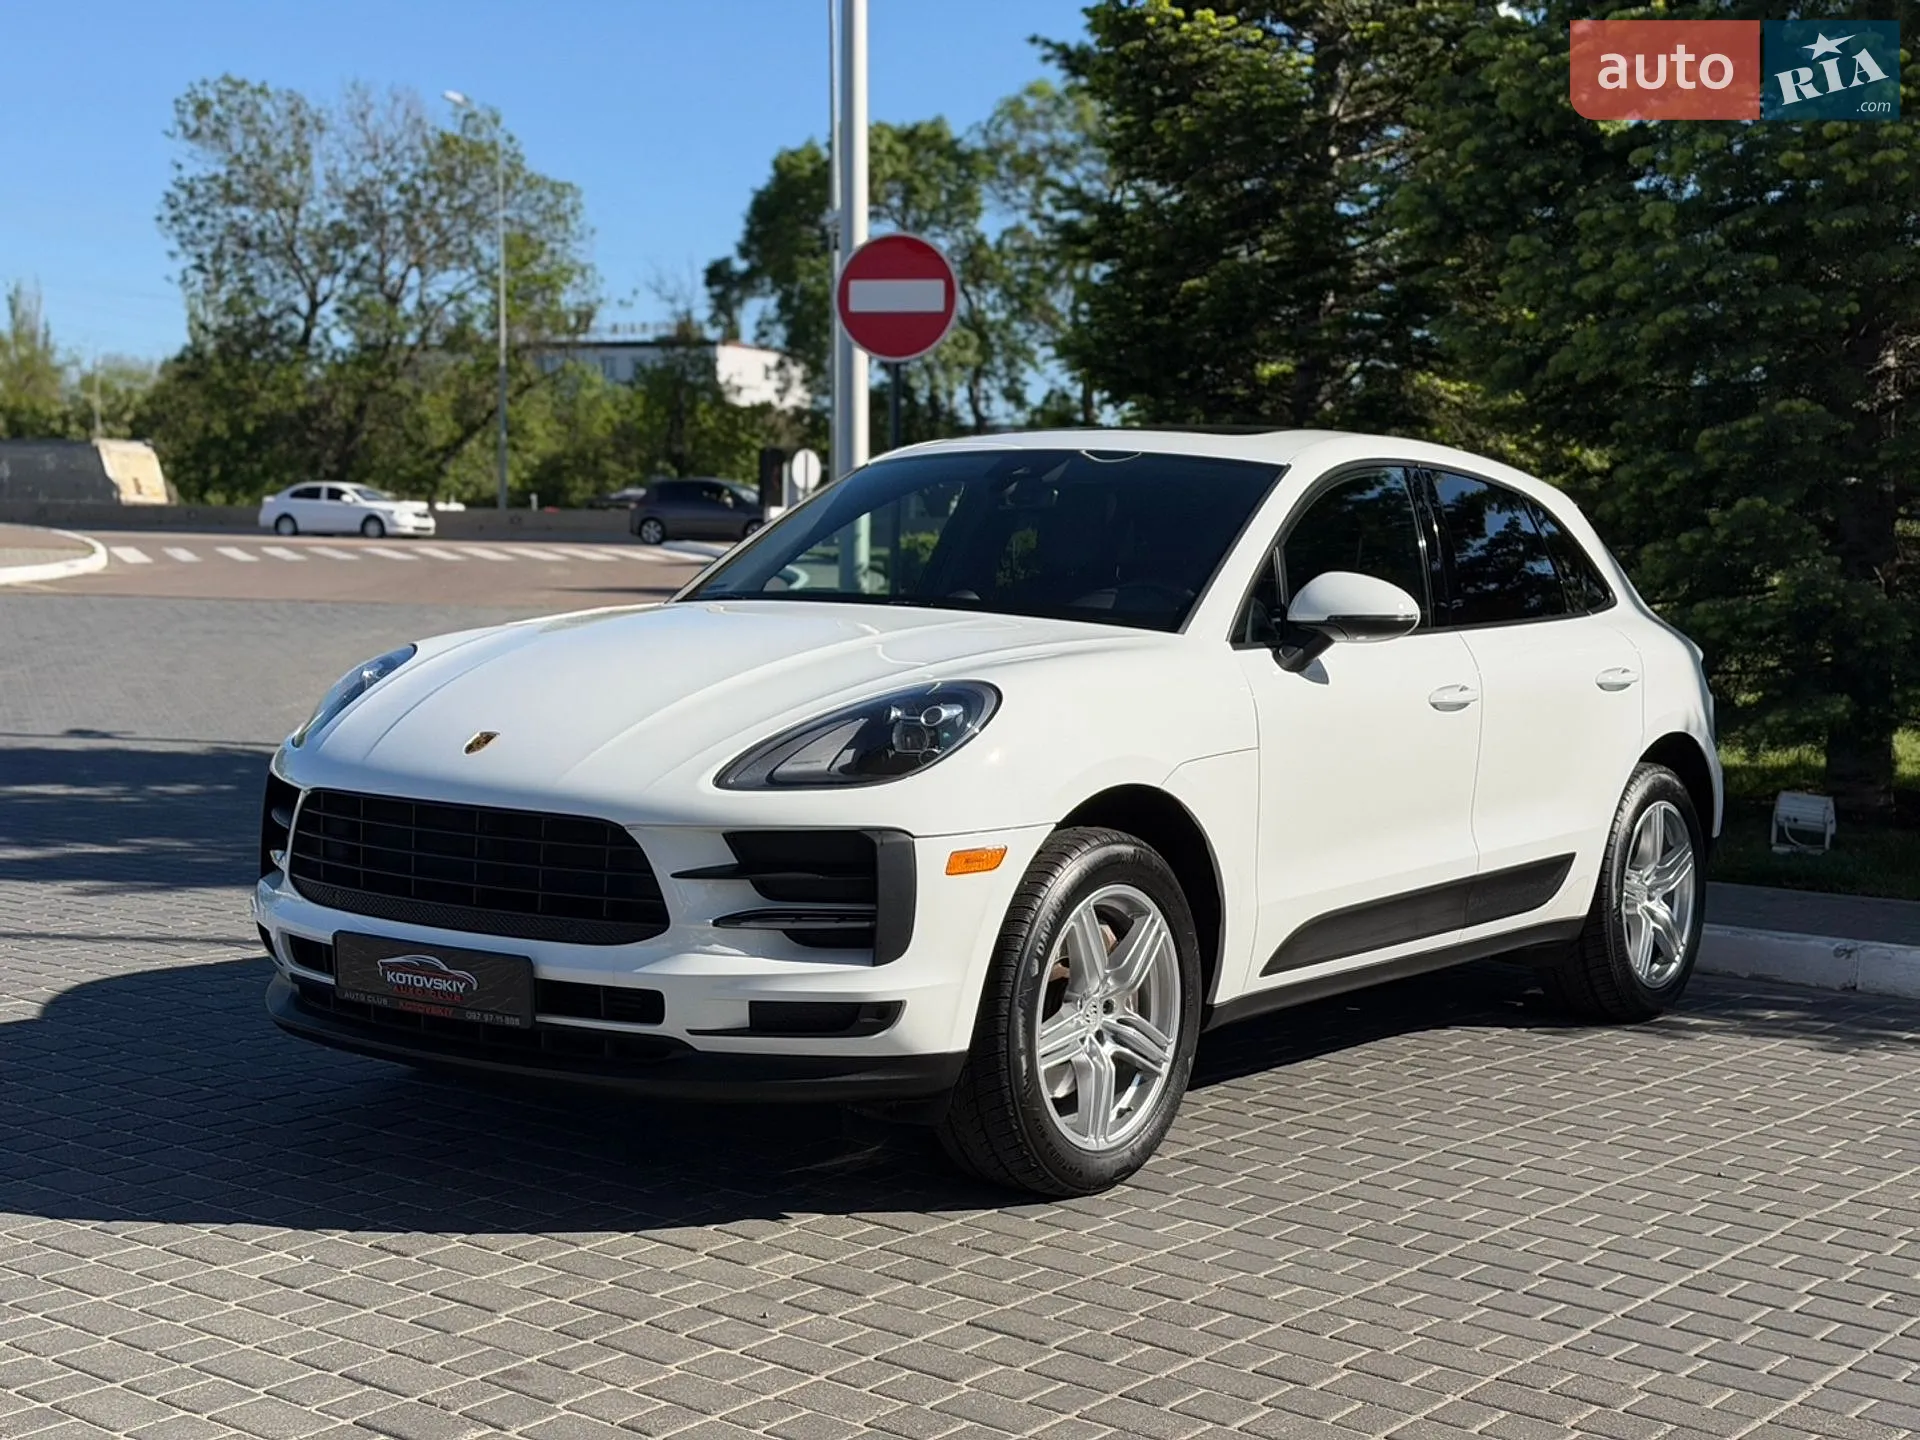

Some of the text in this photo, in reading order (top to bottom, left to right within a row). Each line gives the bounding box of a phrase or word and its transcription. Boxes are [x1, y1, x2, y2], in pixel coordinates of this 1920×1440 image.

[386, 971, 467, 993] KOTOVSKIY
[344, 991, 388, 1006] AUTO CLUB
[393, 985, 463, 1003] AUTO CLUB
